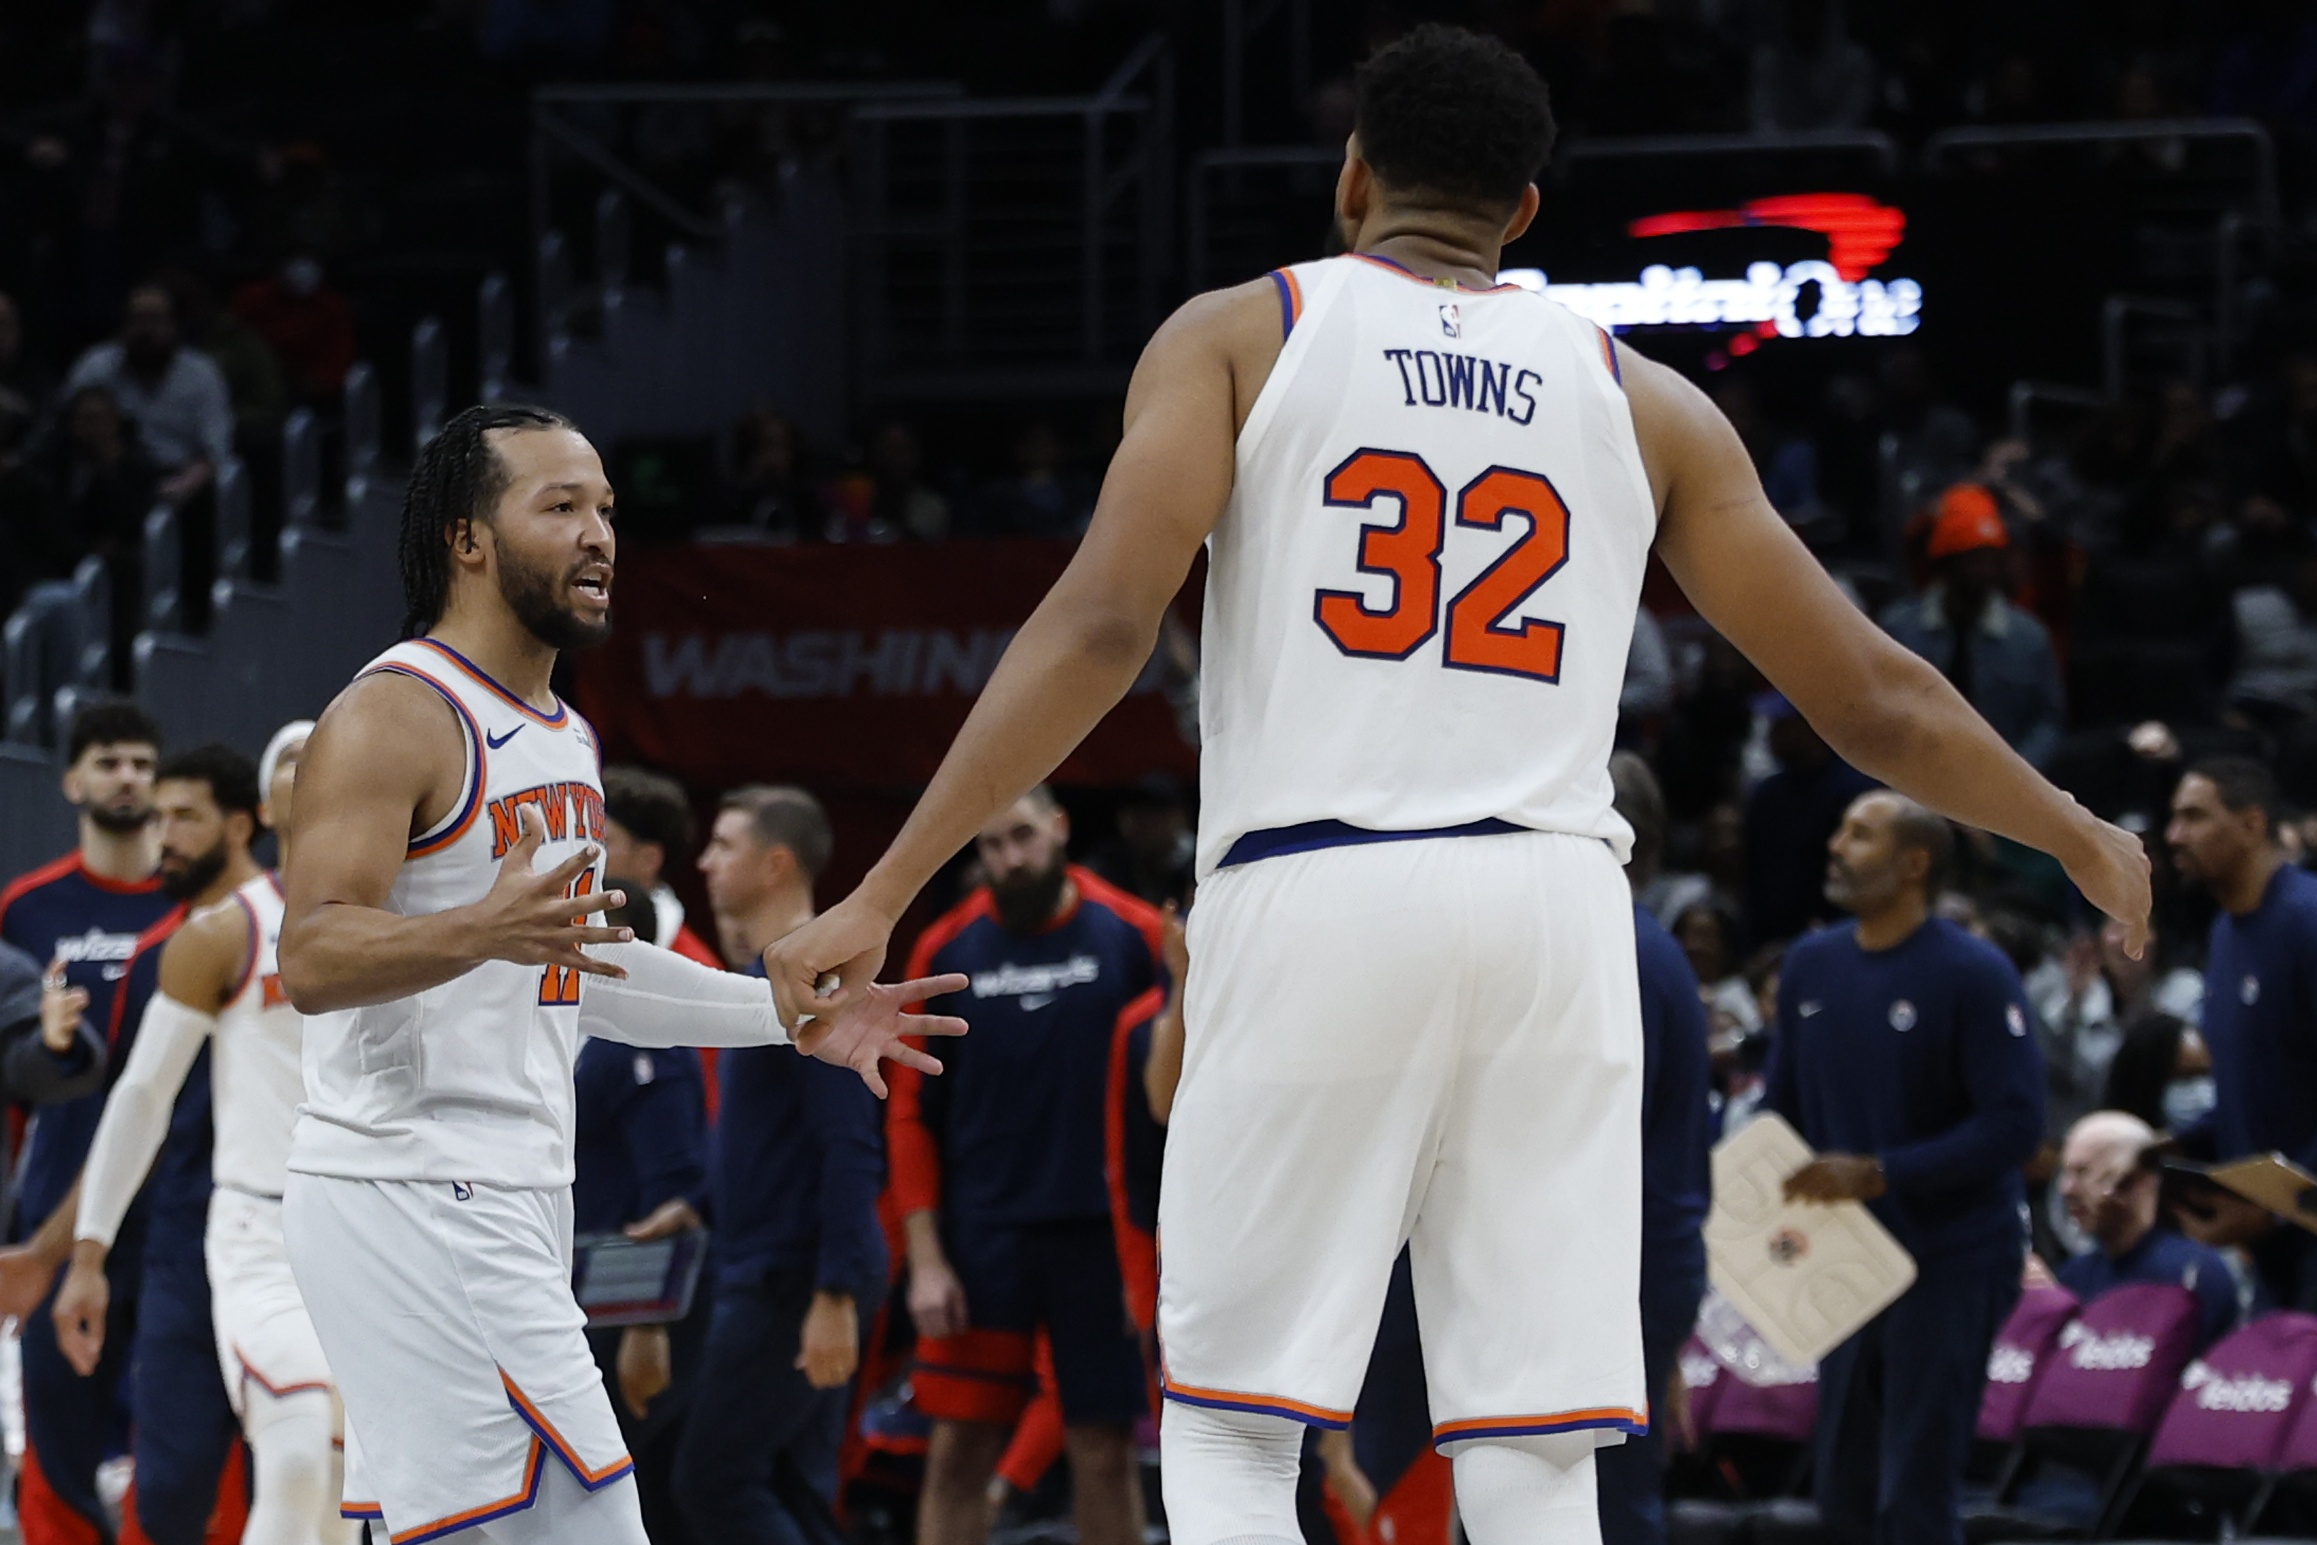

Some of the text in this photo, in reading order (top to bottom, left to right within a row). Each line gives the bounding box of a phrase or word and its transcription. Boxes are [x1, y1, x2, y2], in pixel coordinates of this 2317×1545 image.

[1384, 350, 1543, 426] TOWNS
[1313, 446, 1571, 686] 32
[641, 630, 1021, 699] WASHIN
